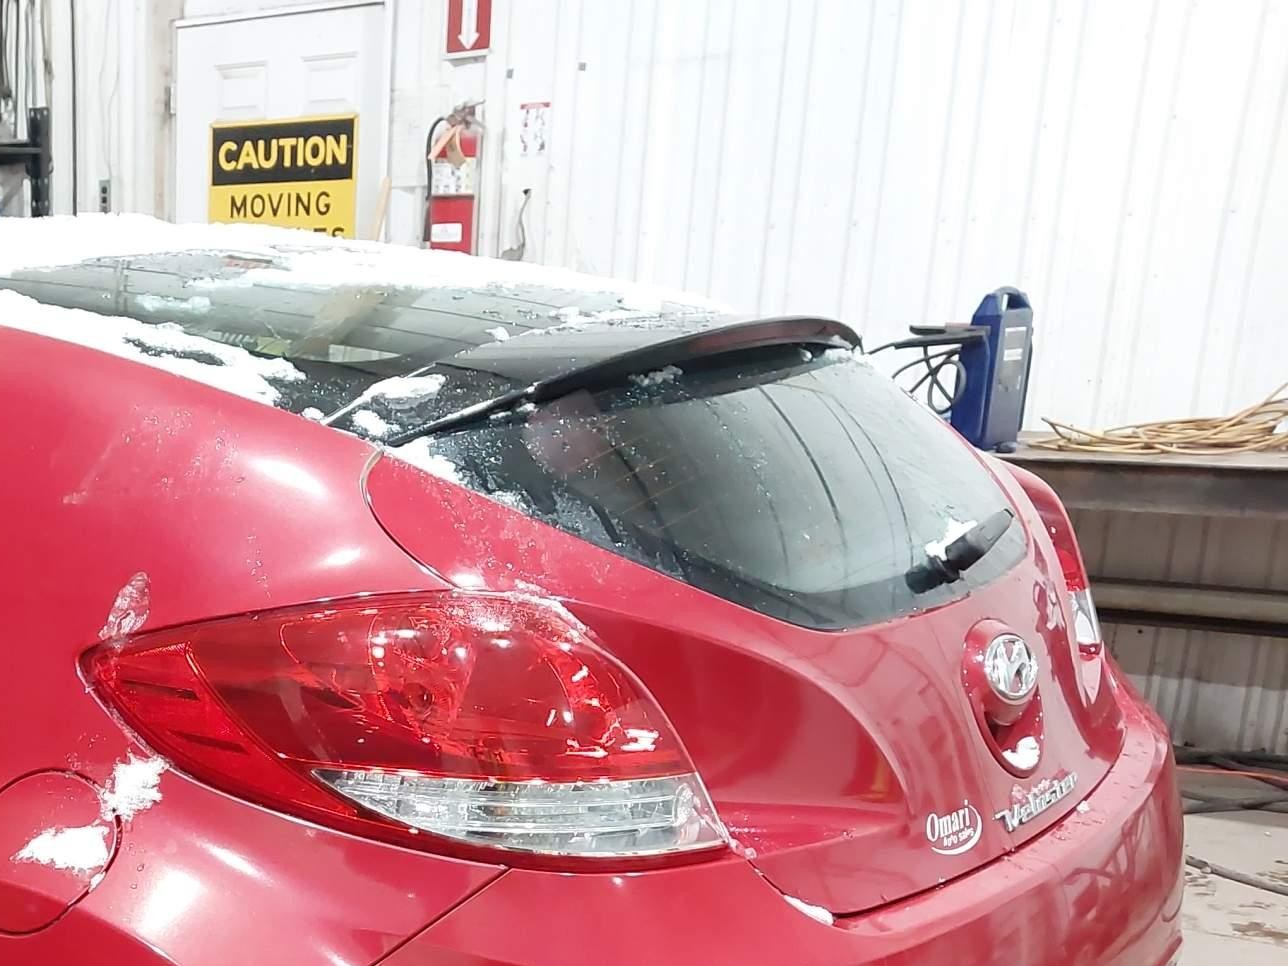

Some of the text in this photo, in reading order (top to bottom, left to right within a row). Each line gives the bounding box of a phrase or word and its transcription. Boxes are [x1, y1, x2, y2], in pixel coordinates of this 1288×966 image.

[218, 134, 348, 172] CAUTION
[230, 191, 331, 219] MOVING
[926, 799, 971, 843] Omari
